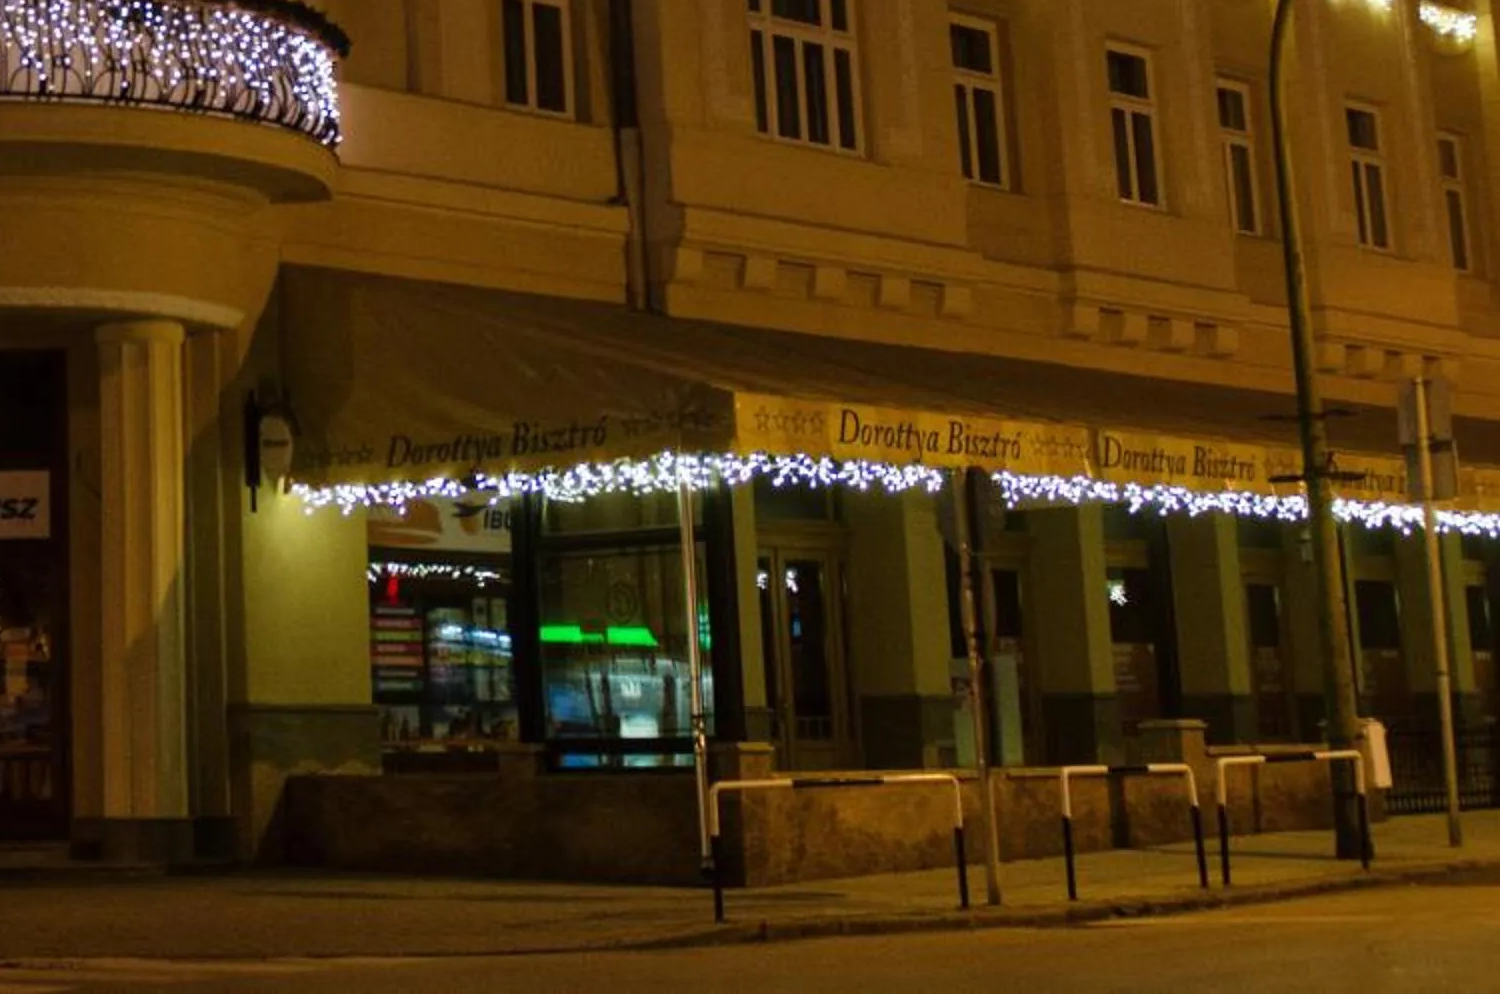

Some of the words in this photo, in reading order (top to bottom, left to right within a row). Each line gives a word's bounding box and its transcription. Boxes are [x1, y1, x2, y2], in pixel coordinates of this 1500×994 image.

[387, 433, 501, 467] Dorottya
[512, 415, 609, 455] Bisztró
[838, 408, 939, 457] Dorottya
[947, 420, 1022, 459] Bisztró
[1103, 435, 1186, 479] Dorottya
[1192, 445, 1255, 482] Bisztró
